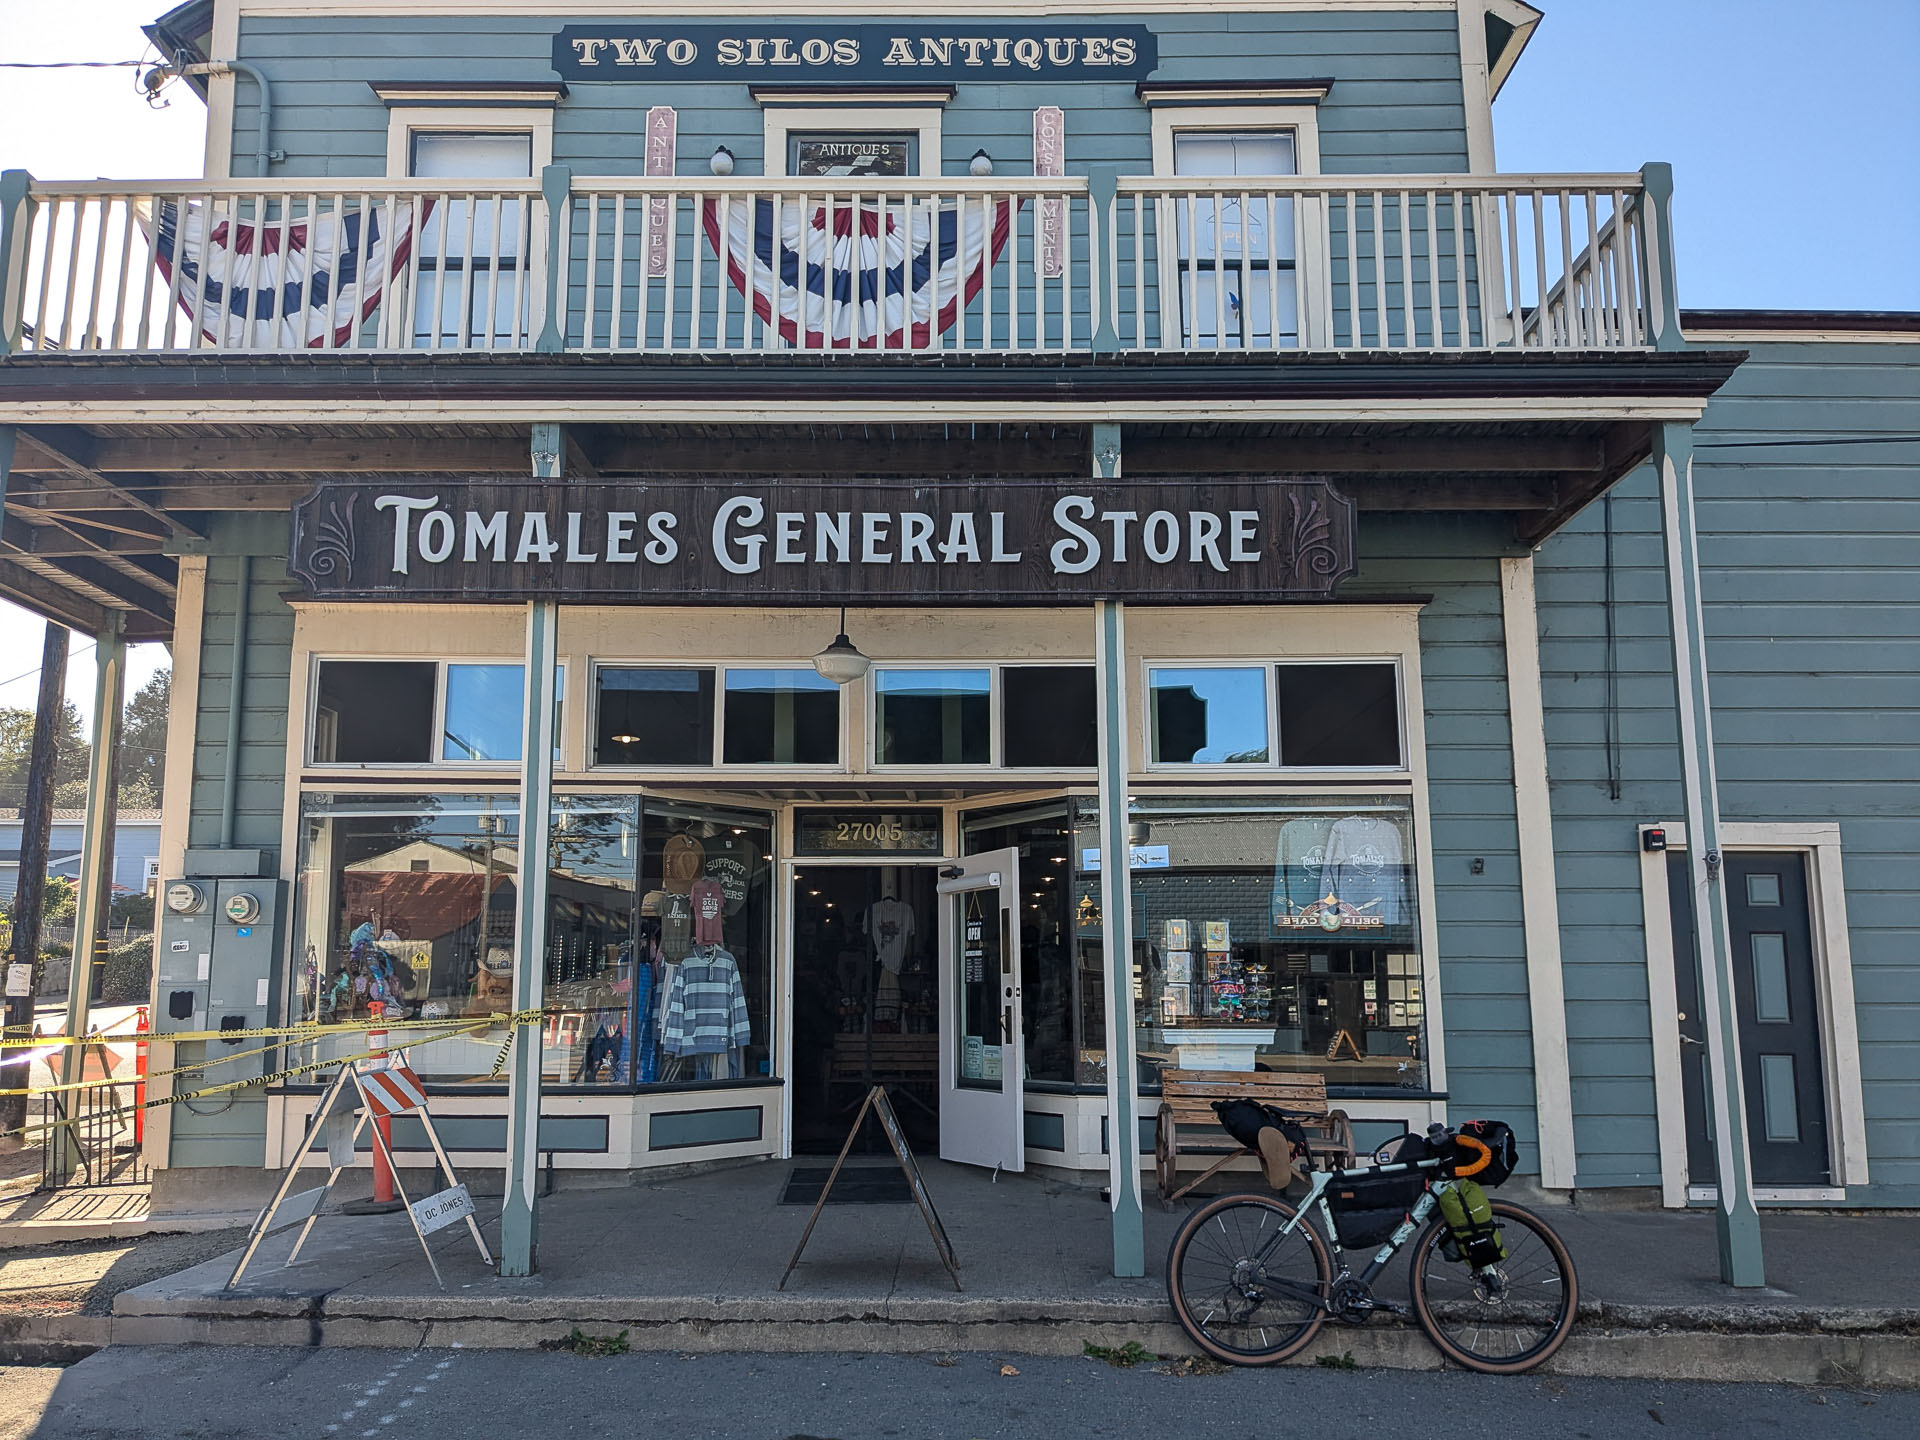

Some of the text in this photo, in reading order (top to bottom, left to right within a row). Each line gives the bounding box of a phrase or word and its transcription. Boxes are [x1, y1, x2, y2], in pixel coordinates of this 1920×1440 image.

[572, 37, 1137, 71] TWO SILOS ANTIQUES
[819, 143, 890, 156] ANTIQUES
[651, 116, 667, 267] ANTQUES
[1042, 113, 1056, 272] CONSIMENTS
[375, 495, 1262, 575] TOMALES GENERAL STORE
[836, 822, 903, 841] 27005
[706, 857, 746, 875] SUPPORT
[967, 927, 981, 940] OPEN
[425, 1196, 464, 1220] OC JONES
